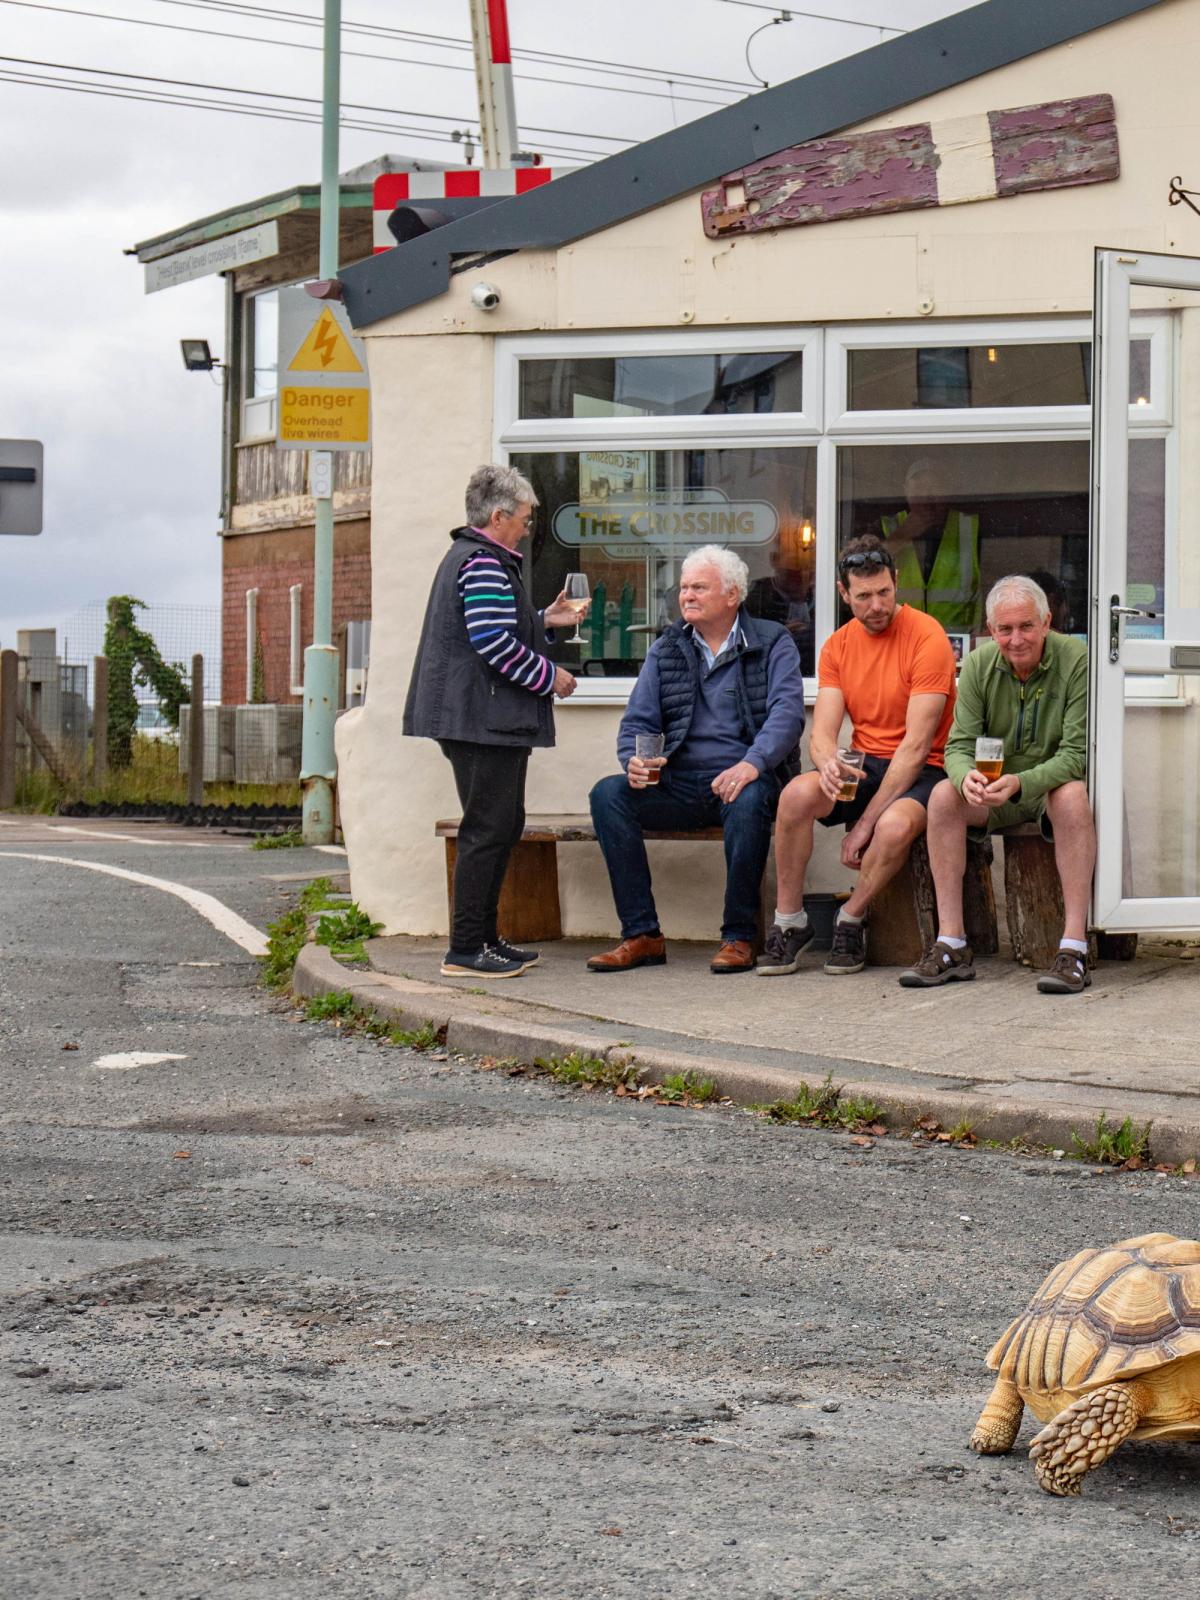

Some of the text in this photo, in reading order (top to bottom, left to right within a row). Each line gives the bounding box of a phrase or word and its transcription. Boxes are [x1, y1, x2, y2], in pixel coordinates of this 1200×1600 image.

[191, 253, 207, 269] level
[207, 243, 237, 265] crossing
[284, 390, 355, 410] Danger
[283, 415, 343, 426] Overhead
[283, 428, 340, 438] live wires
[575, 511, 755, 537] THE CROSSING
